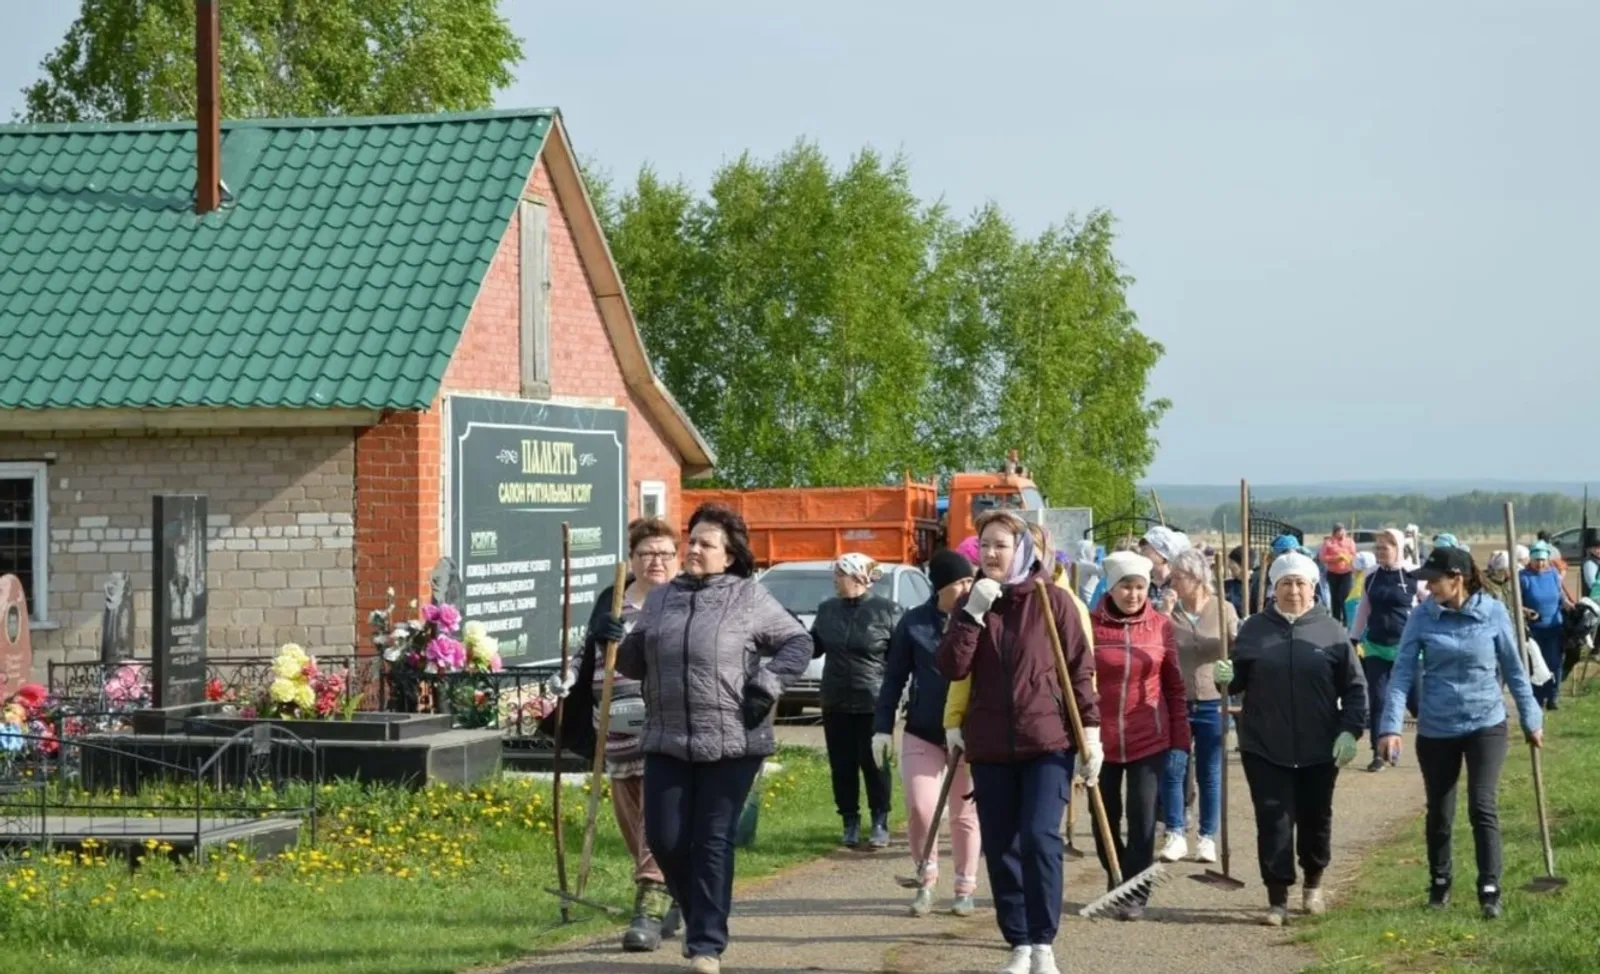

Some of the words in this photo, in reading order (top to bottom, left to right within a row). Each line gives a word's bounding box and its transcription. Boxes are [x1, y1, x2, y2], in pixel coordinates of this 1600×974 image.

[521, 440, 577, 475] ПАМЯТЬ
[498, 483, 526, 503] САЛОН
[527, 483, 572, 503] РИТУАЛЬНЫХ
[573, 484, 593, 503] УСЛУГ
